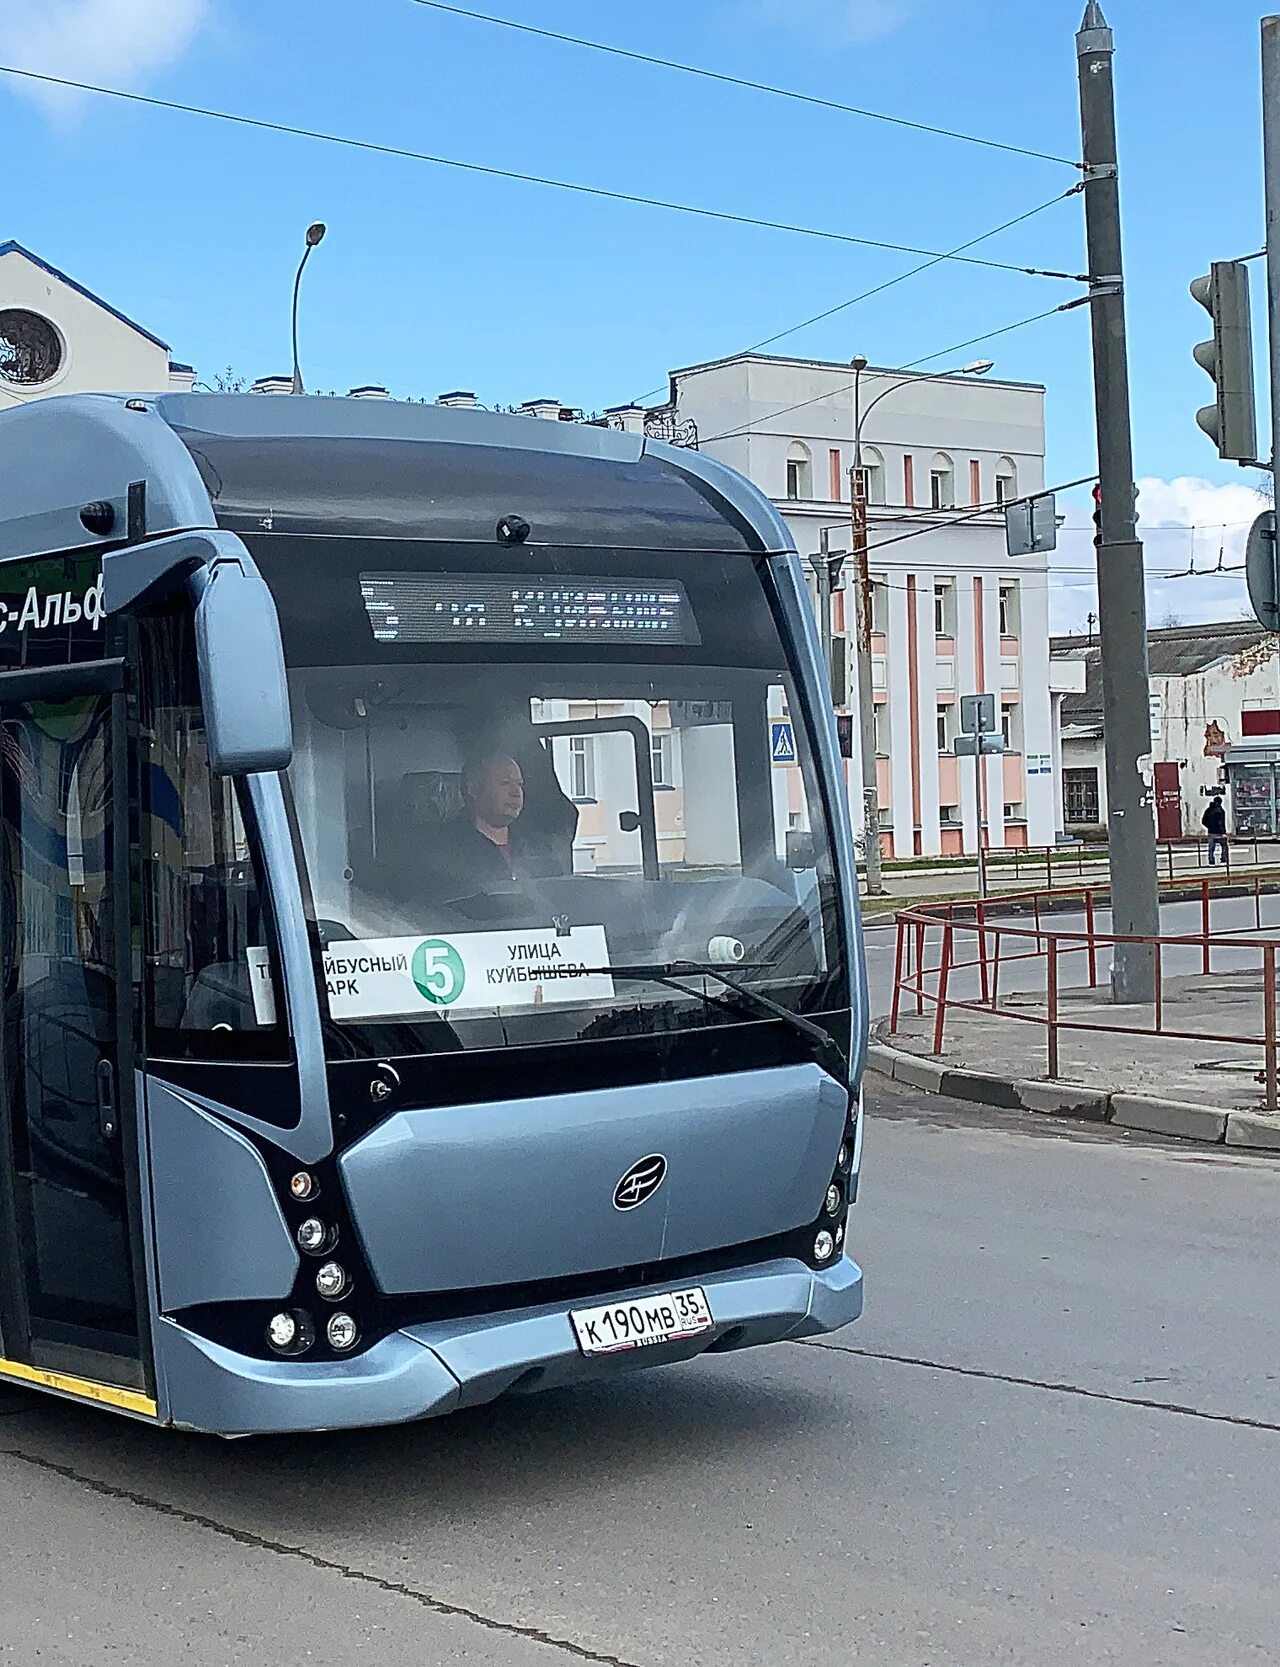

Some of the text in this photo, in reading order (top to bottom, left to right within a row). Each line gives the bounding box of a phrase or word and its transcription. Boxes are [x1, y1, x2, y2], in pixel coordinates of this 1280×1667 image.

[507, 942, 562, 961] УЛИЦА
[424, 946, 455, 999] 5
[485, 962, 590, 984] КУЙБЫШЕВА
[675, 1293, 700, 1317] 35
[680, 1316, 698, 1326] RUS
[635, 1335, 669, 1348] RUSSIA
